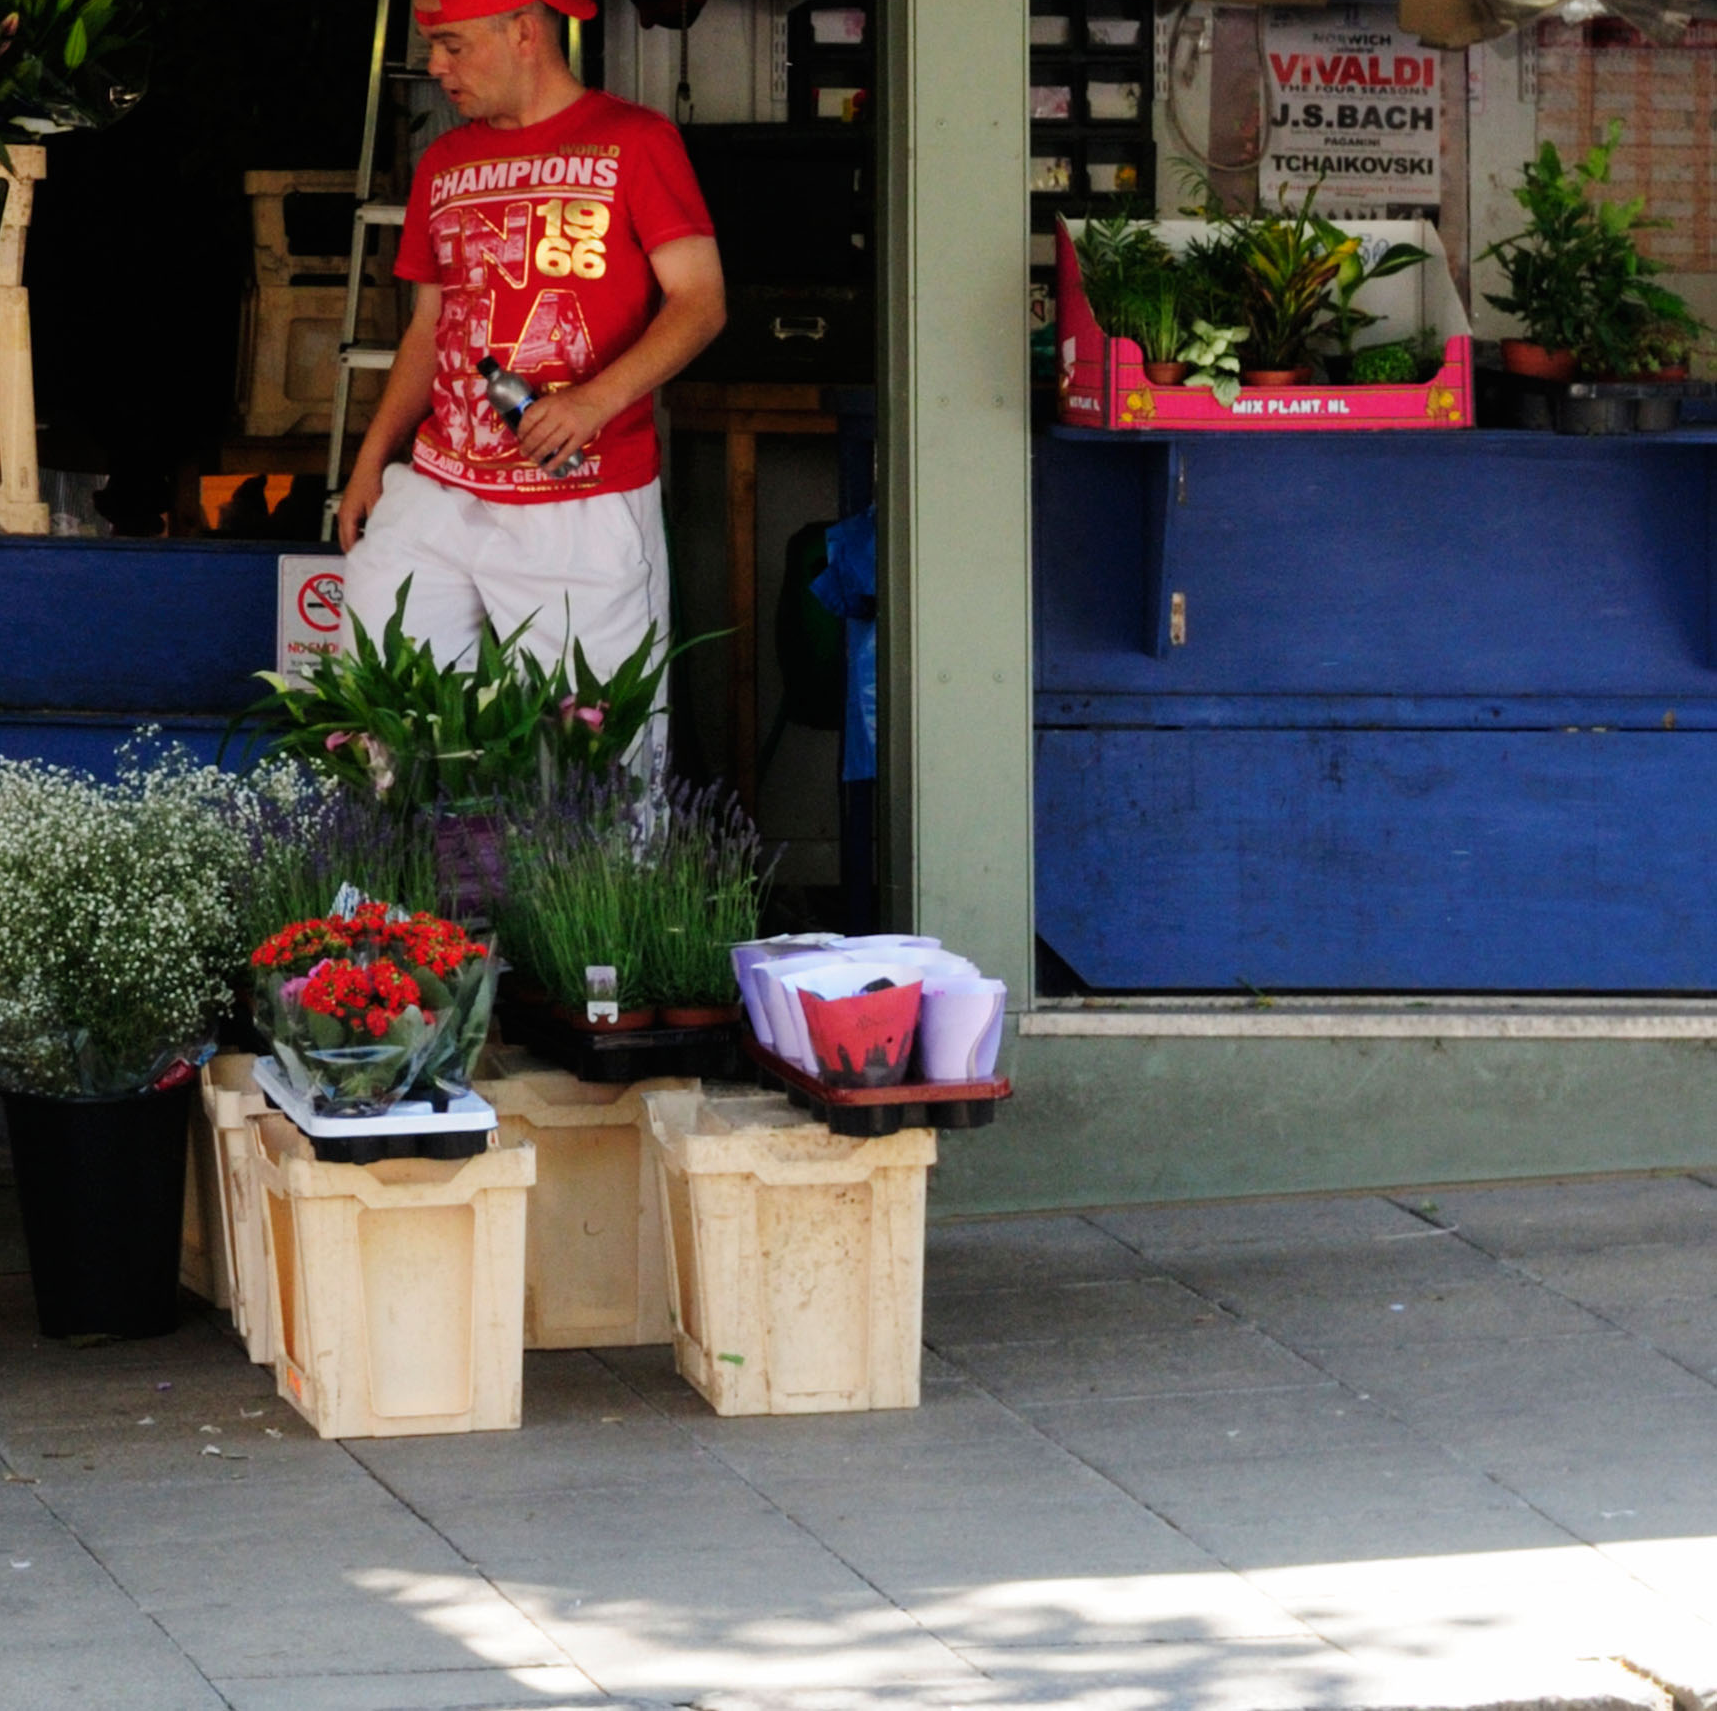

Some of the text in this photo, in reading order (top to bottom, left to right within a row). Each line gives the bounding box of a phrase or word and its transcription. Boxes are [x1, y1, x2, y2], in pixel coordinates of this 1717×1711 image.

[1313, 33, 1392, 46] NORWICH
[1269, 53, 1435, 87] VIVALDI
[1280, 85, 1428, 96] THE FOUR SEASONS
[1324, 137, 1381, 147] PAGANINI
[559, 143, 621, 159] WORLD
[1271, 155, 1434, 175] TCHAIKOVSKI
[430, 156, 620, 207] CHAMPIONS
[1232, 399, 1263, 414] MIX
[496, 469, 507, 484] 2
